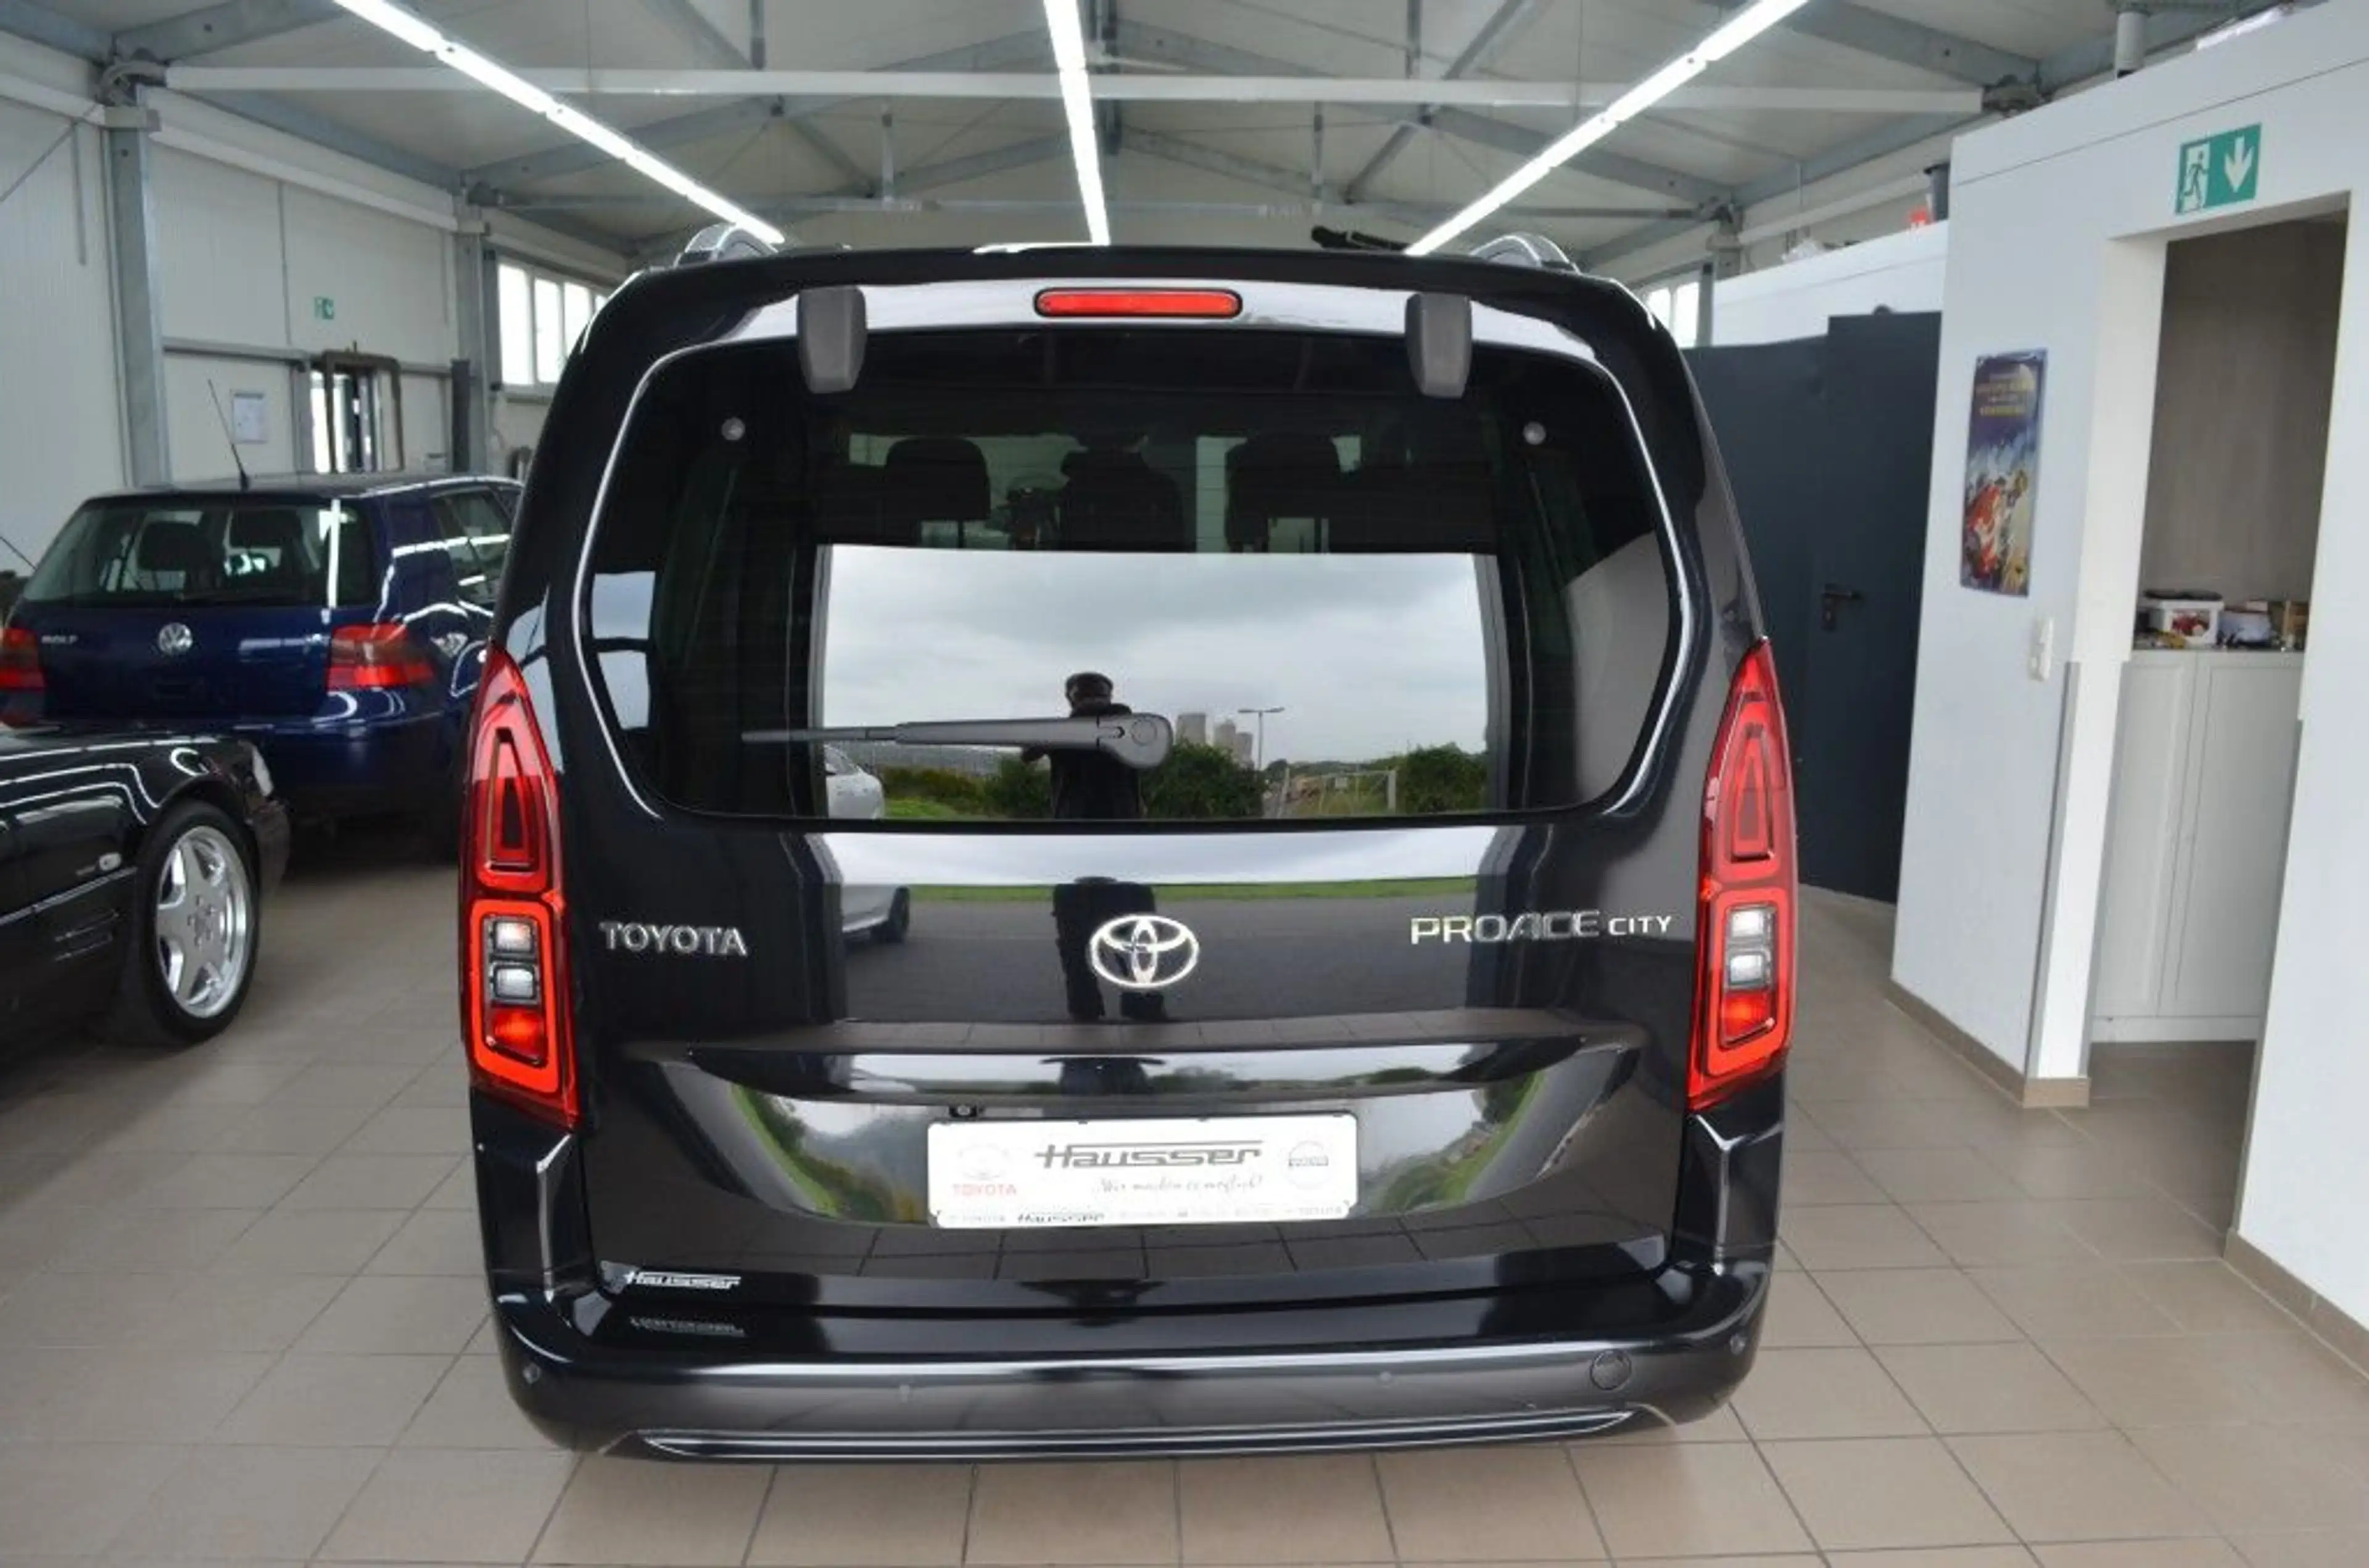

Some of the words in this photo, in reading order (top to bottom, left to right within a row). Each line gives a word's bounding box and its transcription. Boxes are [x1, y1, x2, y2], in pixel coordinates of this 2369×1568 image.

[598, 922, 747, 956] TOYOTA
[1410, 909, 1600, 944] PROACE
[1608, 915, 1671, 936] CITY
[1035, 1140, 1264, 1170] Hausser
